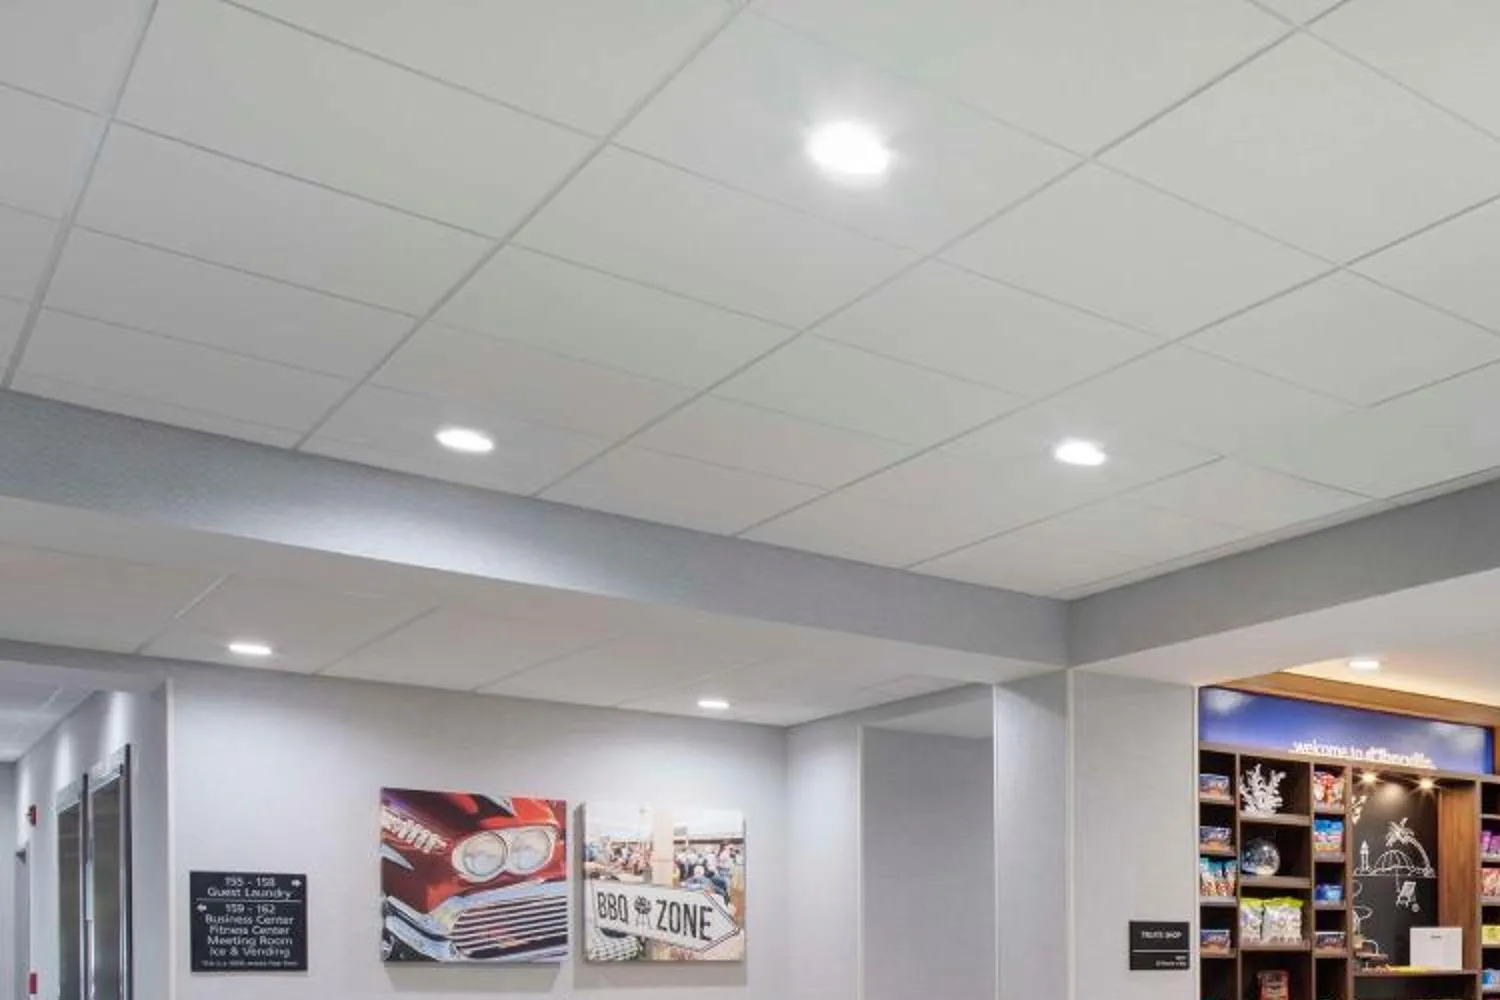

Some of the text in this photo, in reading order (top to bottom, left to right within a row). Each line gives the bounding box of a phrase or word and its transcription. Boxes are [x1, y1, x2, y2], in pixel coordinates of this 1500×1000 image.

[207, 886, 292, 900] Guest Laundry
[205, 913, 294, 925] Business Center
[597, 891, 713, 941] BBQ ZONE
[209, 925, 290, 935] Fitness Center
[207, 935, 293, 947] Meeting Room
[209, 946, 291, 959] Ice & Vending
